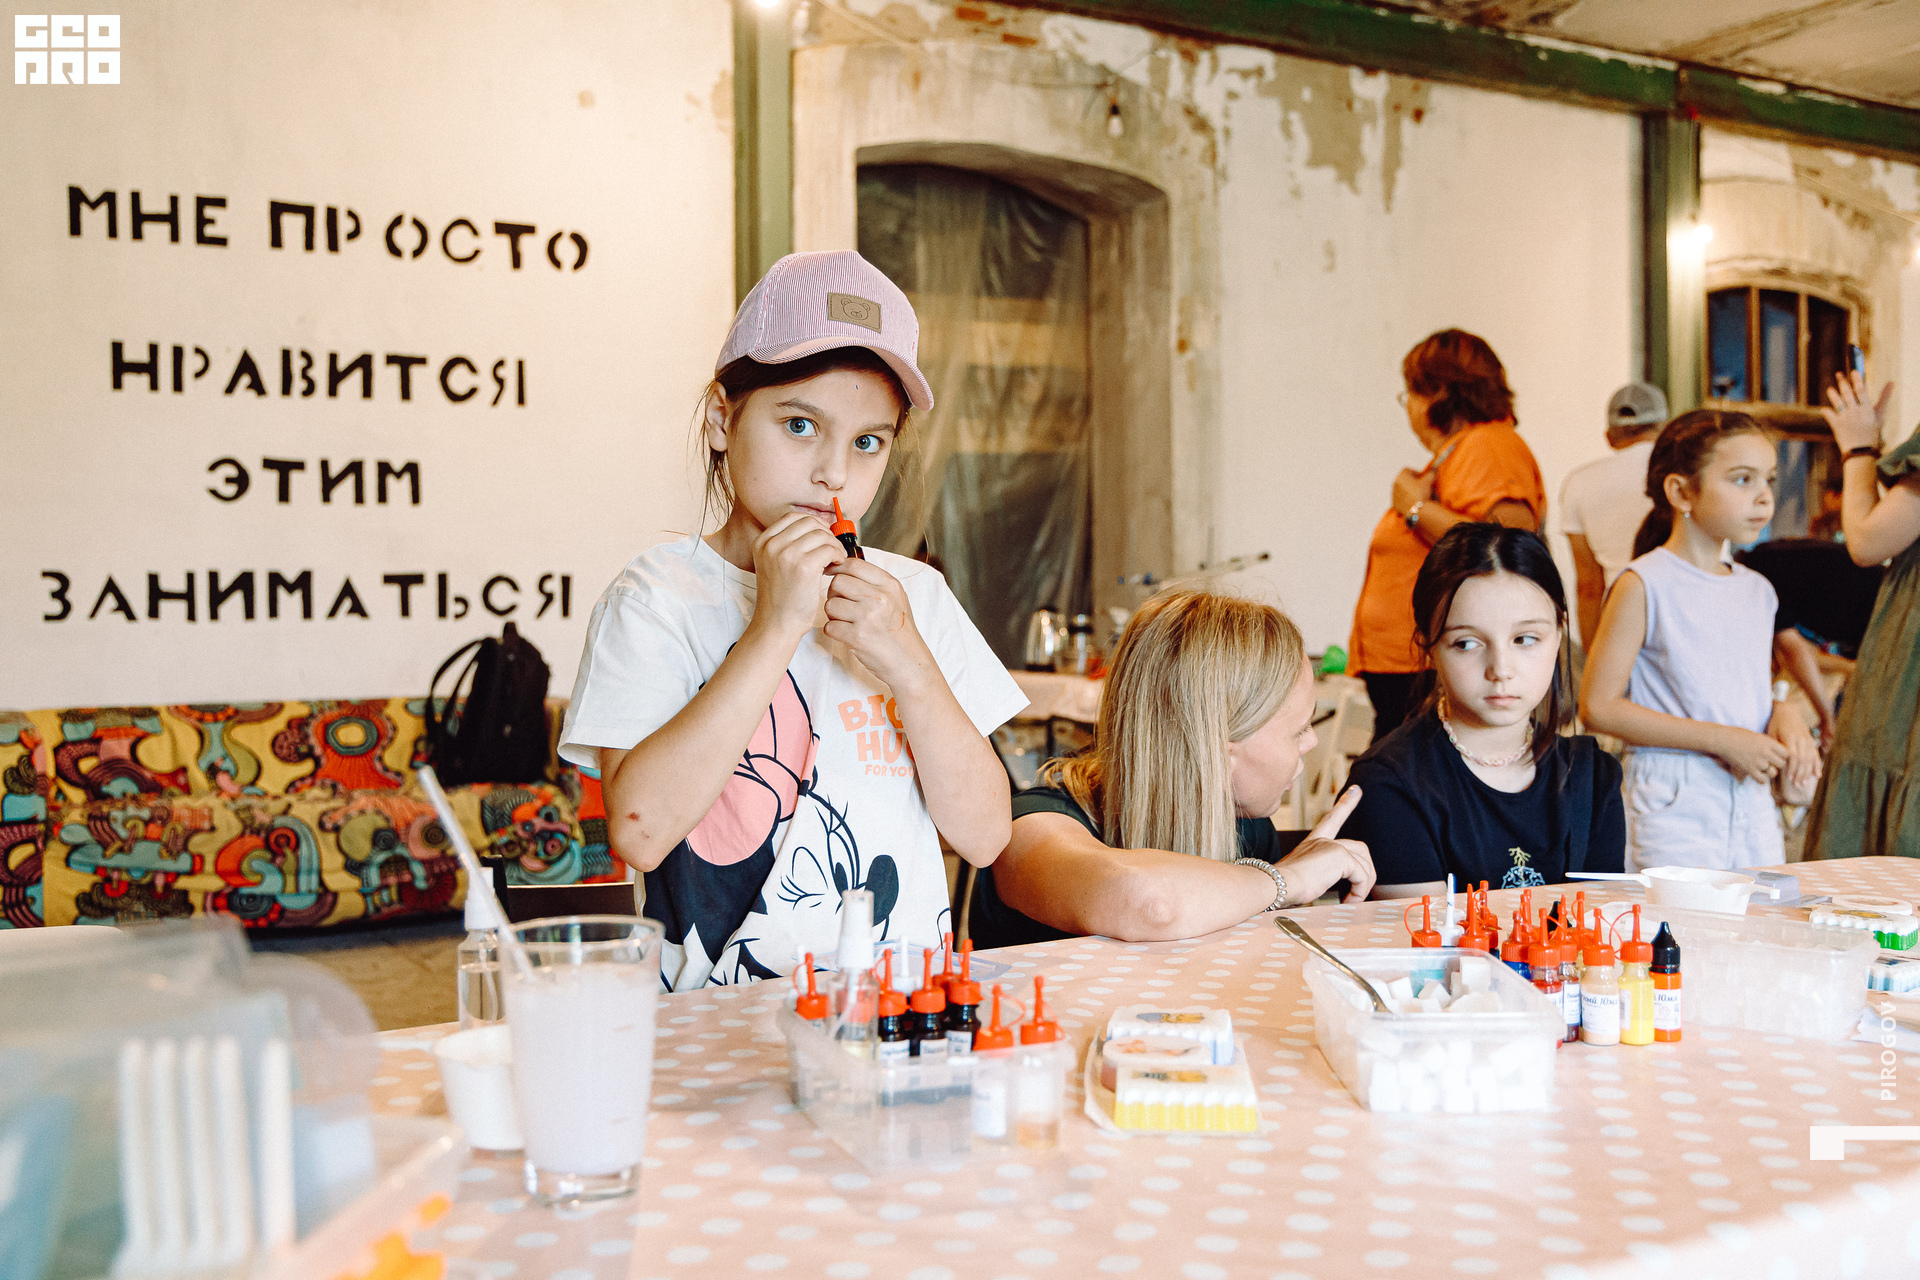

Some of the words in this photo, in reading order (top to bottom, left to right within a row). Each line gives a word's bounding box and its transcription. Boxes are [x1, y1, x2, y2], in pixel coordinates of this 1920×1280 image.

[67, 184, 229, 247] МНЕ
[269, 199, 589, 271] ПРОСТО
[111, 341, 527, 407] НРАВИТСЯ
[207, 457, 422, 505] ЭТИМ
[40, 569, 572, 622] ЗАНИМАТЬСЯ
[856, 729, 915, 764] HU
[865, 764, 887, 777] FOR
